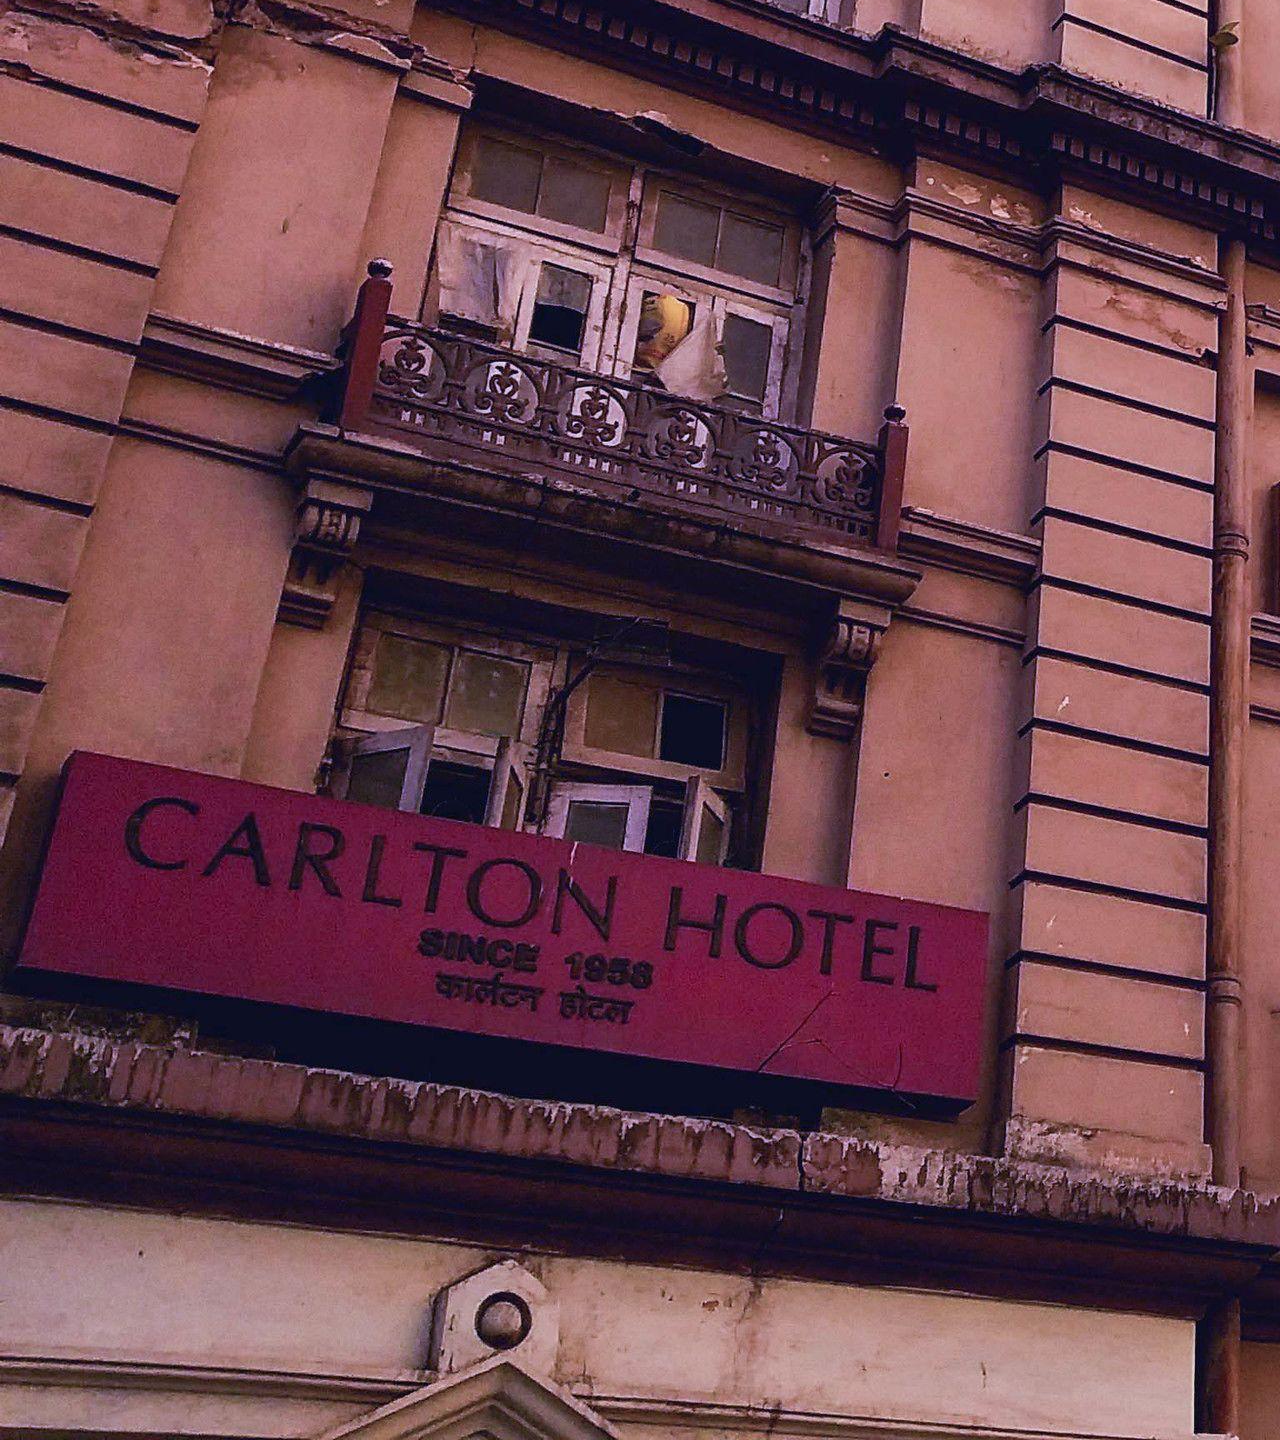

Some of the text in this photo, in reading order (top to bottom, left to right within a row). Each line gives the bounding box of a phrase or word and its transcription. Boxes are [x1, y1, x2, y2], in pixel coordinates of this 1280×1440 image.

[123, 796, 938, 993] CARLTON HOTEL
[417, 927, 655, 989] SINCE 1958
[558, 984, 636, 1024] होटल
